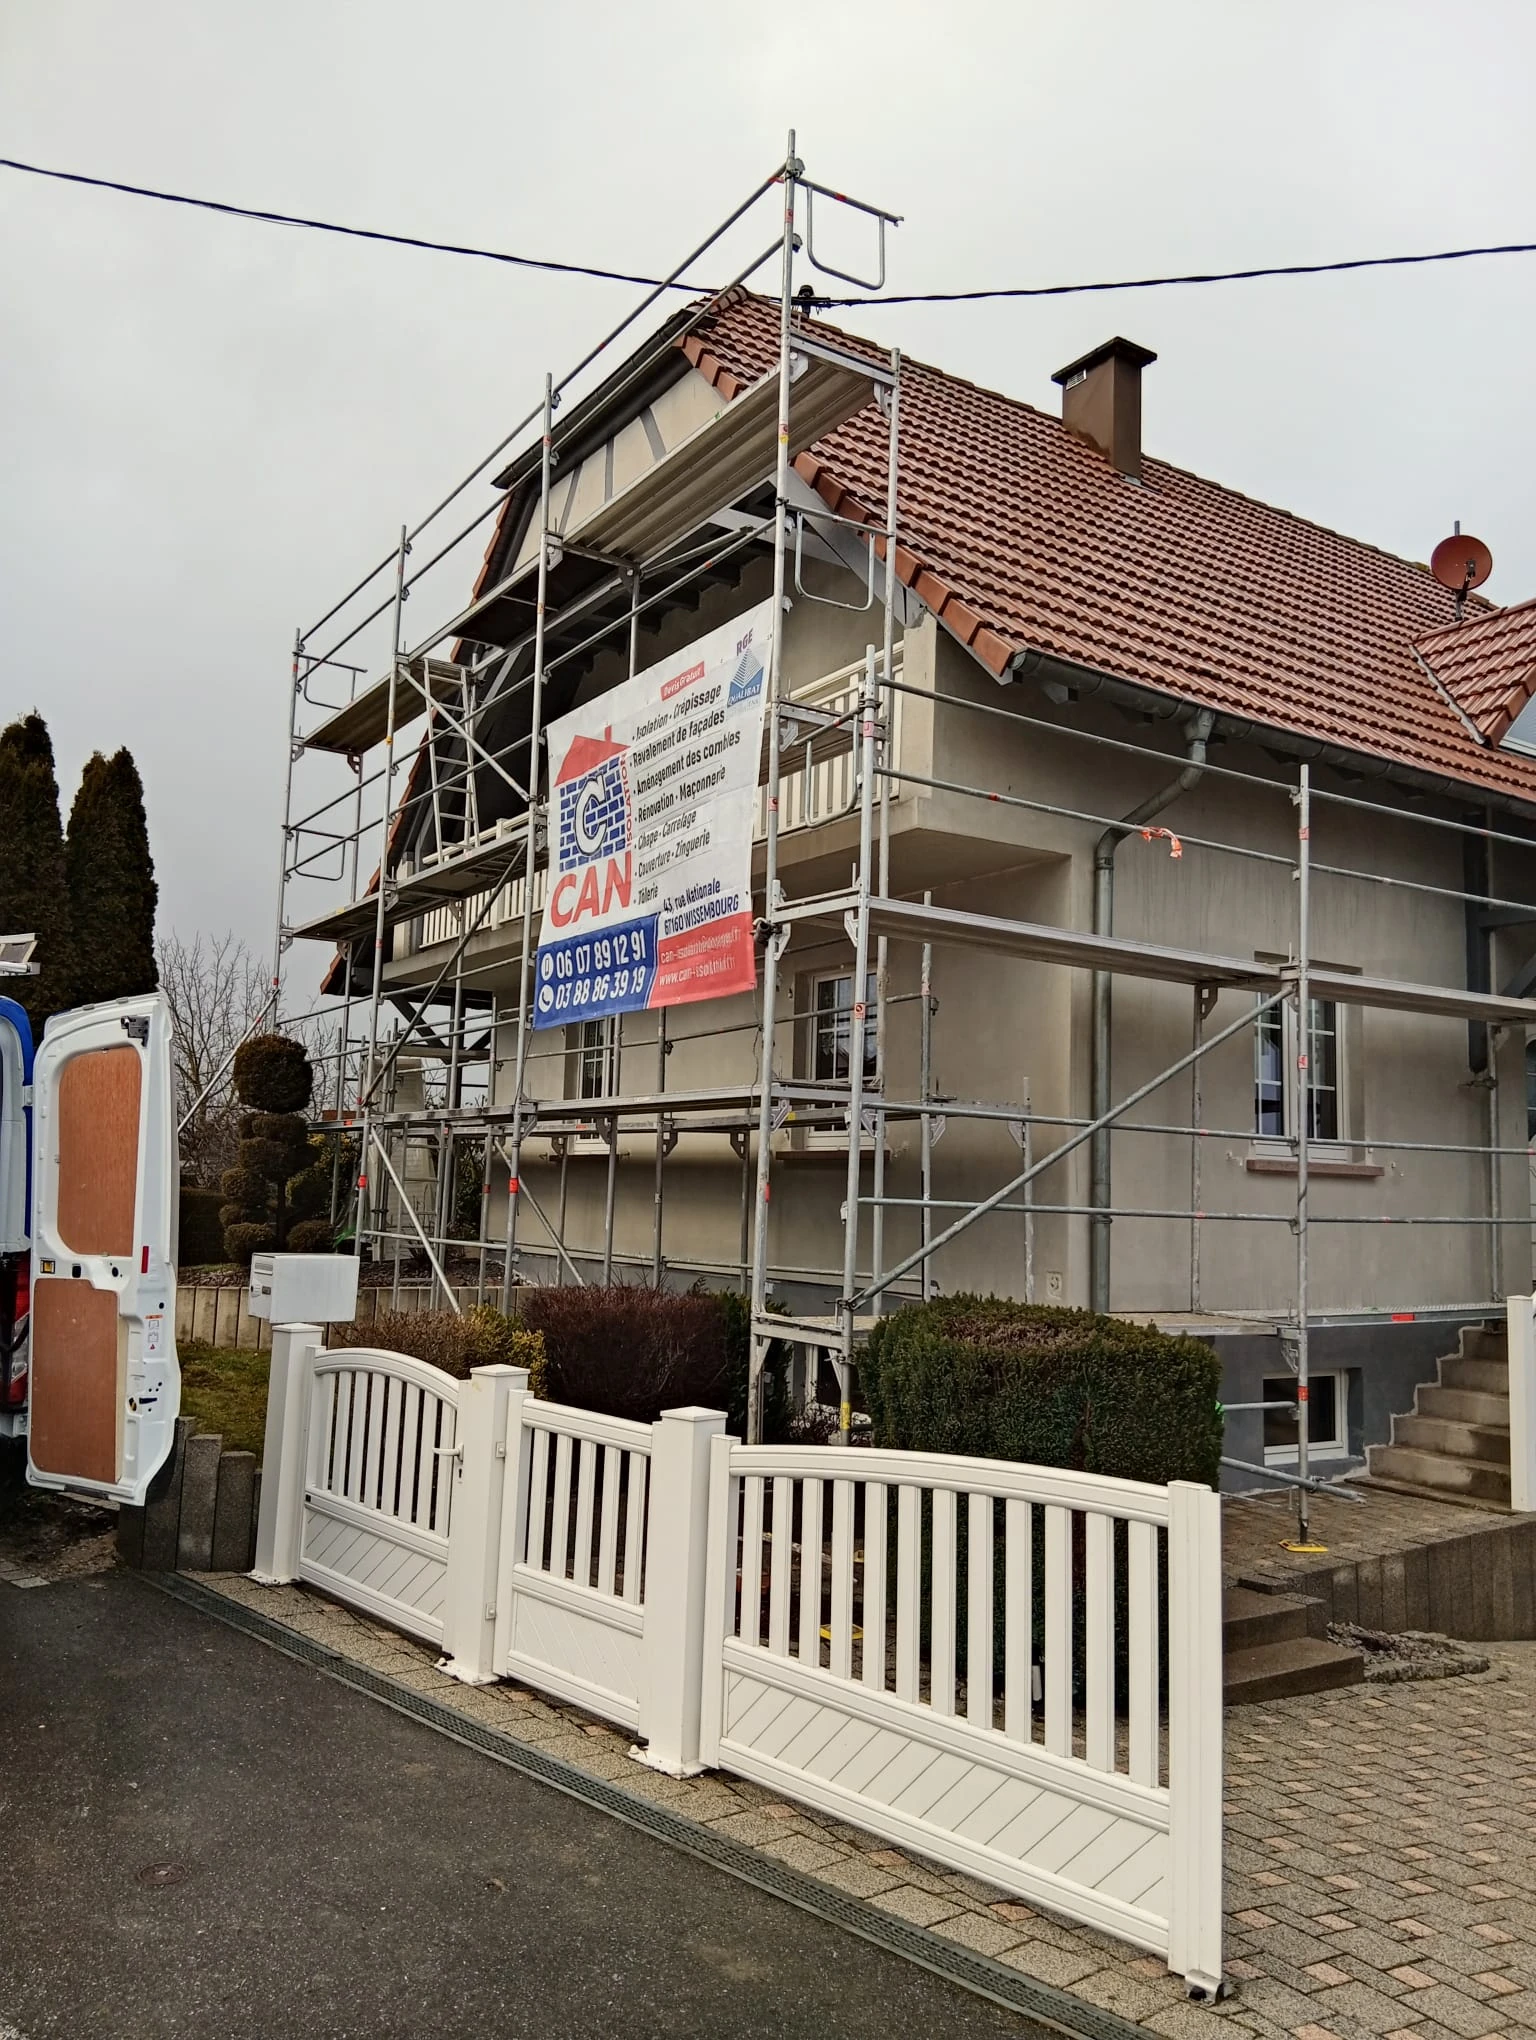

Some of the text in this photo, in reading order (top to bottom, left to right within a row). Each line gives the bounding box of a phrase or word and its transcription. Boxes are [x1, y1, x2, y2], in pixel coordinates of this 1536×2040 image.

[736, 627, 753, 656] RGE
[636, 714, 668, 741] Isolation
[673, 684, 721, 719] Crépissage
[663, 680, 680, 698] Devis
[632, 709, 725, 768] Ravalement de façades
[637, 730, 741, 796] Aménagement des combles
[638, 764, 726, 823] Rénovation Maçonnerie
[638, 810, 697, 851] Chape Carrelage
[638, 829, 711, 878] Couverture Zinguerie
[551, 850, 632, 928] CAN
[675, 894, 687, 911] rue
[686, 878, 721, 905] Nationale
[664, 894, 739, 935] 67160 WISSEMBOURG
[556, 929, 646, 979] 06 07 89 12 91
[555, 965, 646, 1010] 03 88 86 39 19
